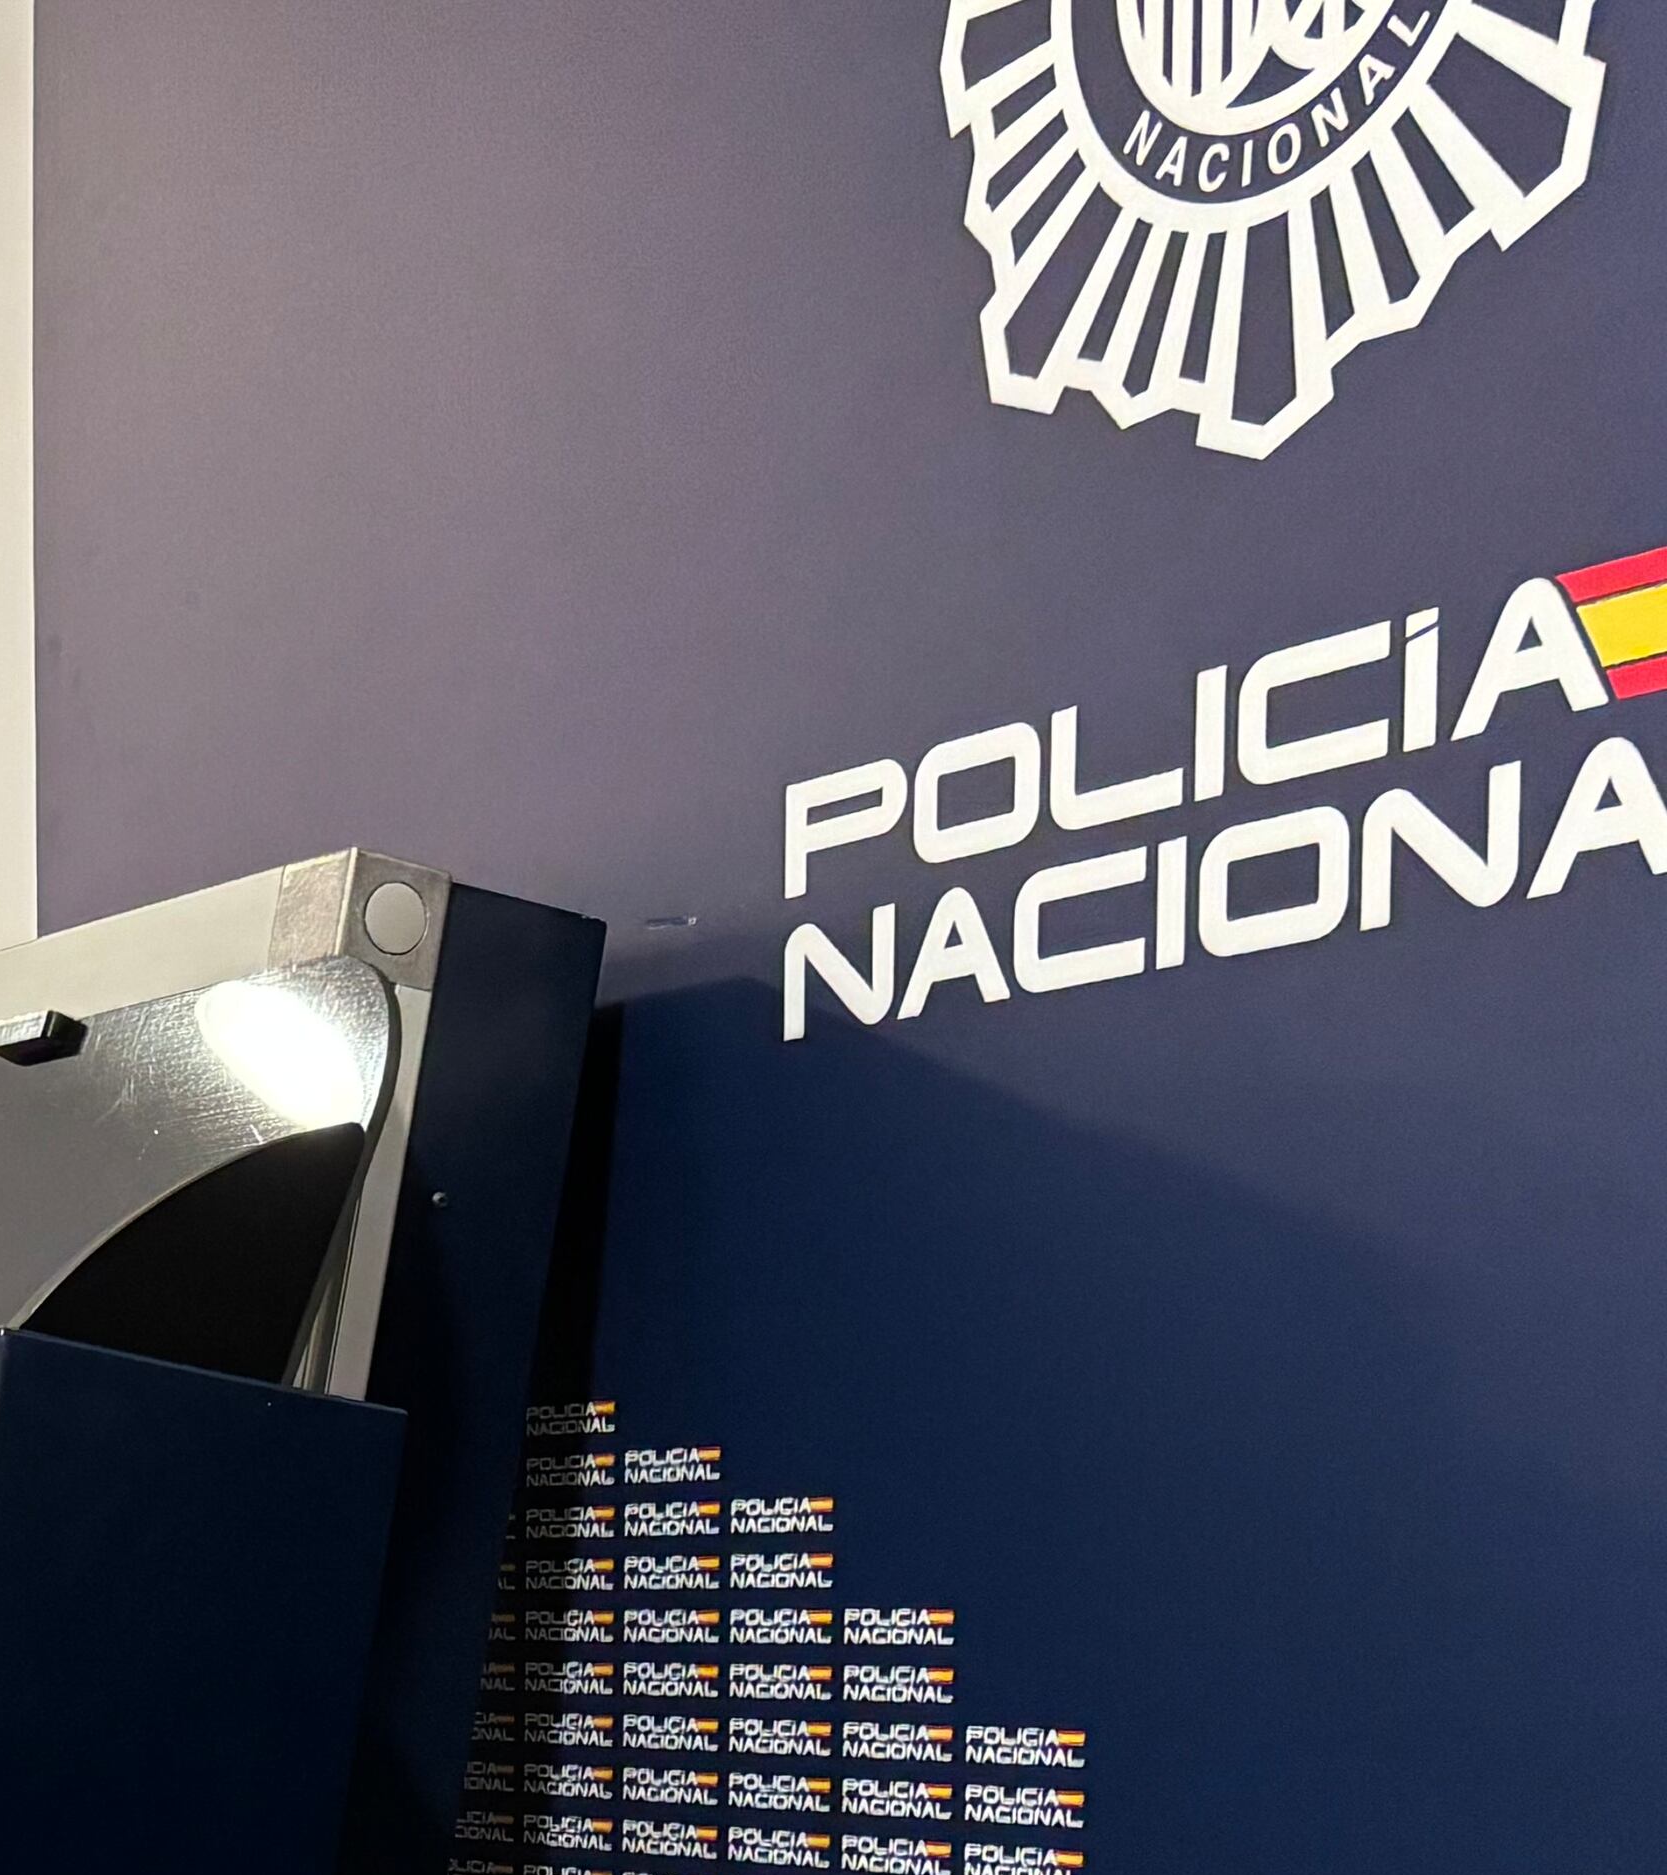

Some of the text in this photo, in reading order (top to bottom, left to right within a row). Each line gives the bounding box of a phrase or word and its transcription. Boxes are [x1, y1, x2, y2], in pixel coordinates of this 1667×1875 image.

[1123, 10, 1431, 193] NACIONAL
[731, 1515, 833, 1533] NACIONAL
[844, 1626, 954, 1645] NACIONAL
[966, 1745, 1085, 1767] NACIONAL
[729, 1790, 830, 1812] NACIONAL
